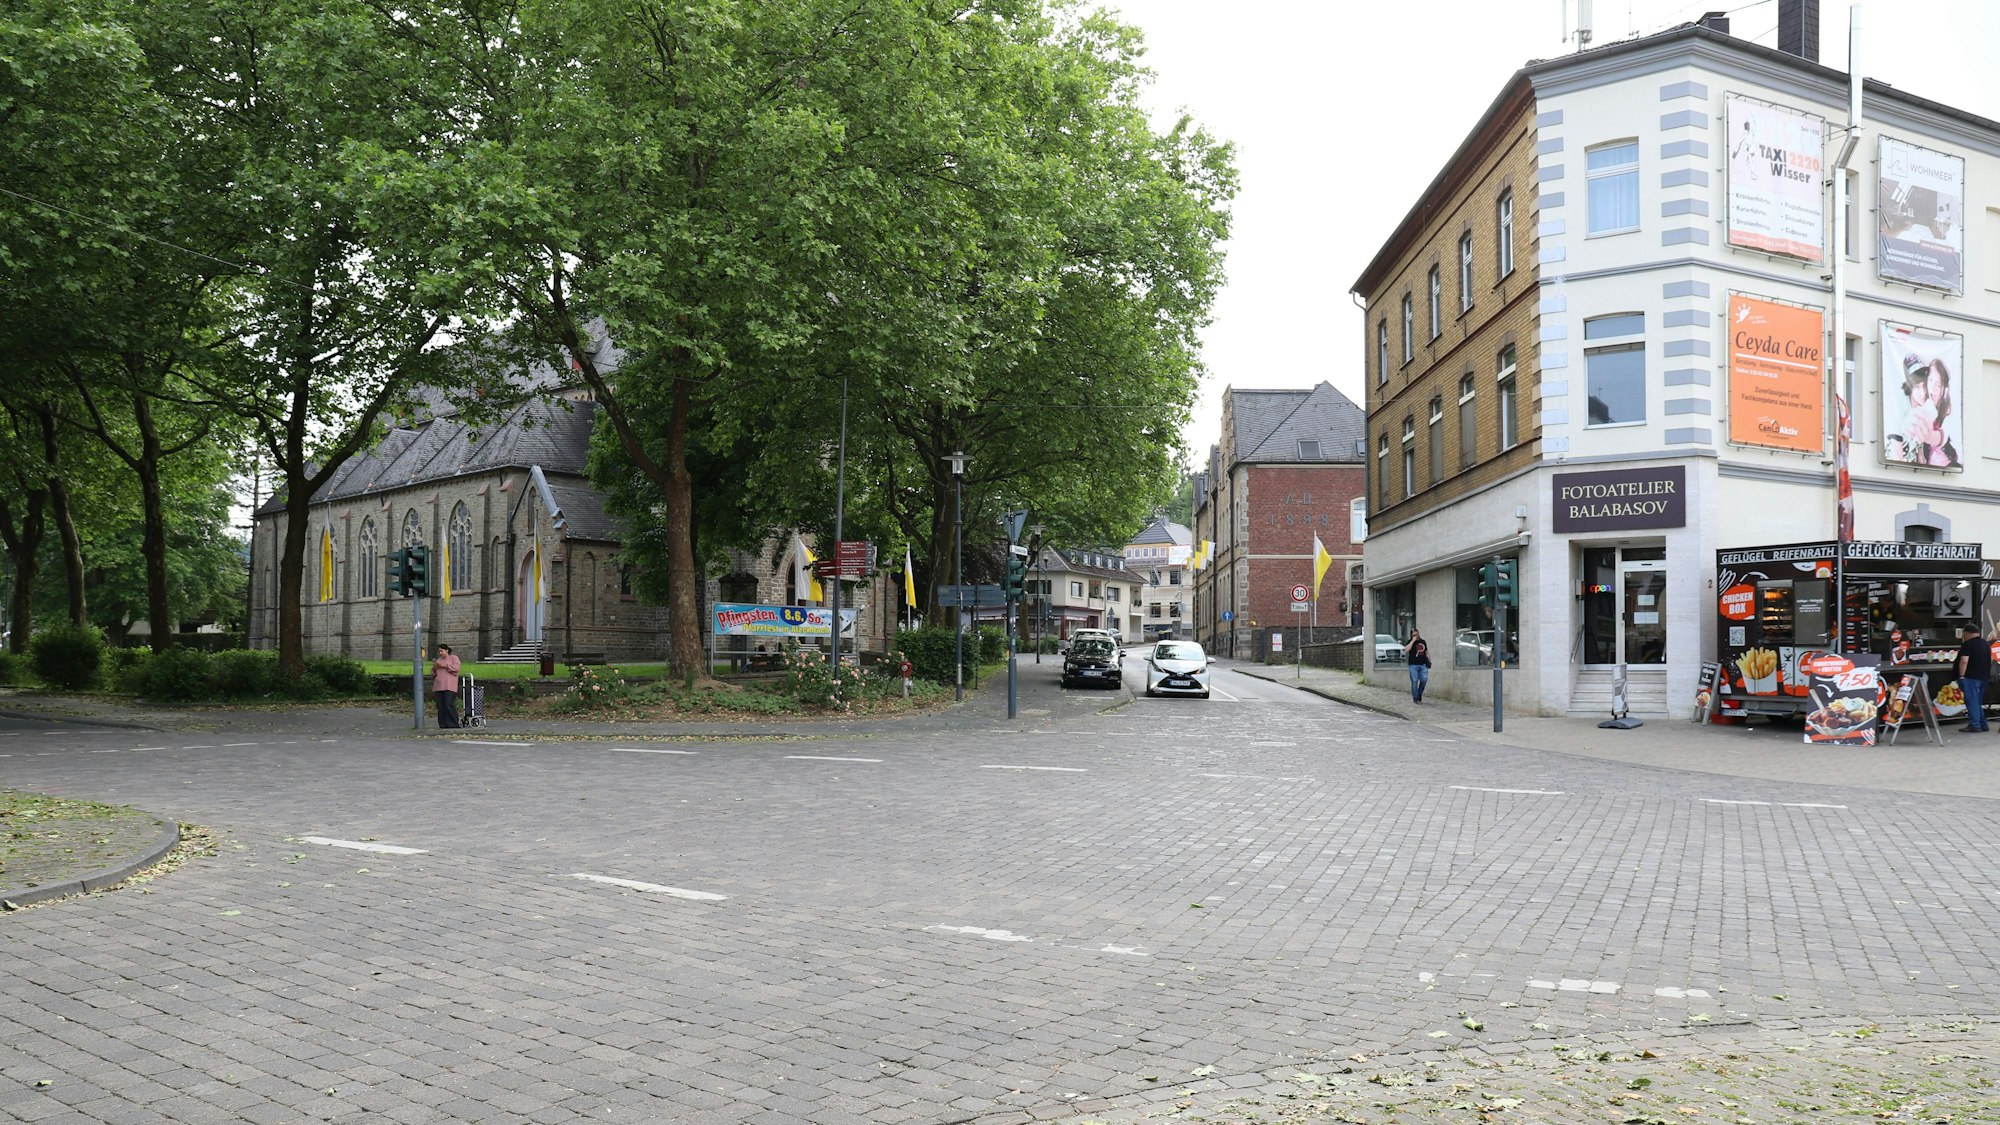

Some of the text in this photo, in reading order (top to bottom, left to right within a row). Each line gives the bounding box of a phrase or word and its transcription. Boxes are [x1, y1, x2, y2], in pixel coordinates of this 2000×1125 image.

[1759, 144, 1819, 171] TAXI 2220
[1770, 163, 1810, 183] Wisser
[1910, 163, 1952, 182] WOHNMEER
[1736, 331, 1818, 361] Ceyda Care
[1742, 393, 1778, 404] Fachkompetenz
[1759, 424, 1799, 436] Can Aktiv
[1562, 480, 1676, 500] FOTOATELIER
[1569, 500, 1668, 519] BALABASOV
[1722, 547, 1835, 563] GEFLÜGEL REIFENRATH
[1848, 544, 1976, 558] GEFLÜGEL REIFENRATH
[1590, 584, 1611, 593] open
[1708, 579, 1712, 588] 2
[1295, 589, 1305, 598] 30
[1722, 592, 1753, 604] CHICKEN
[1729, 603, 1746, 614] BOX
[717, 609, 824, 629] Pfingsten, 8.6. So.
[743, 624, 779, 633] Pfarrfest
[1840, 674, 1872, 686] 7,50
